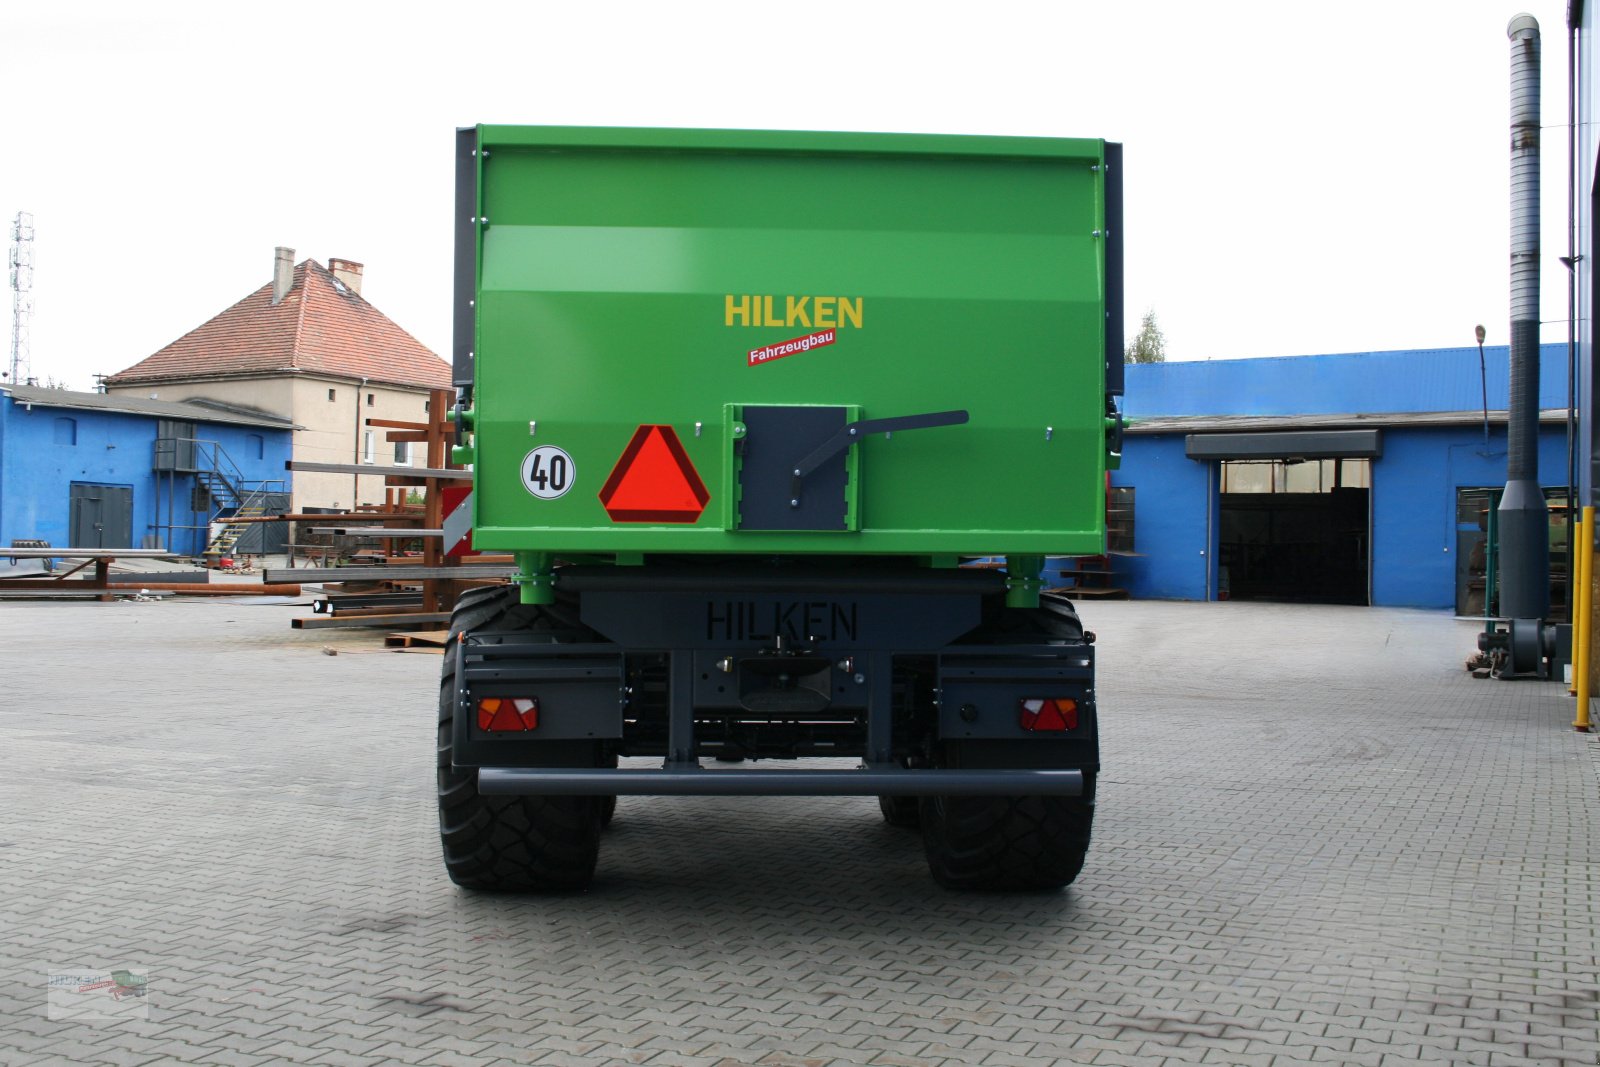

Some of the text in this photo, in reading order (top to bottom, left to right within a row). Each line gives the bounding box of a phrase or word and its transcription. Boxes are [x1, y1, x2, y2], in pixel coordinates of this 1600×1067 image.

[725, 295, 863, 328] HILKEN
[750, 332, 834, 363] Fahrzeugbau
[530, 454, 566, 491] 40
[707, 602, 856, 641] HILKEN
